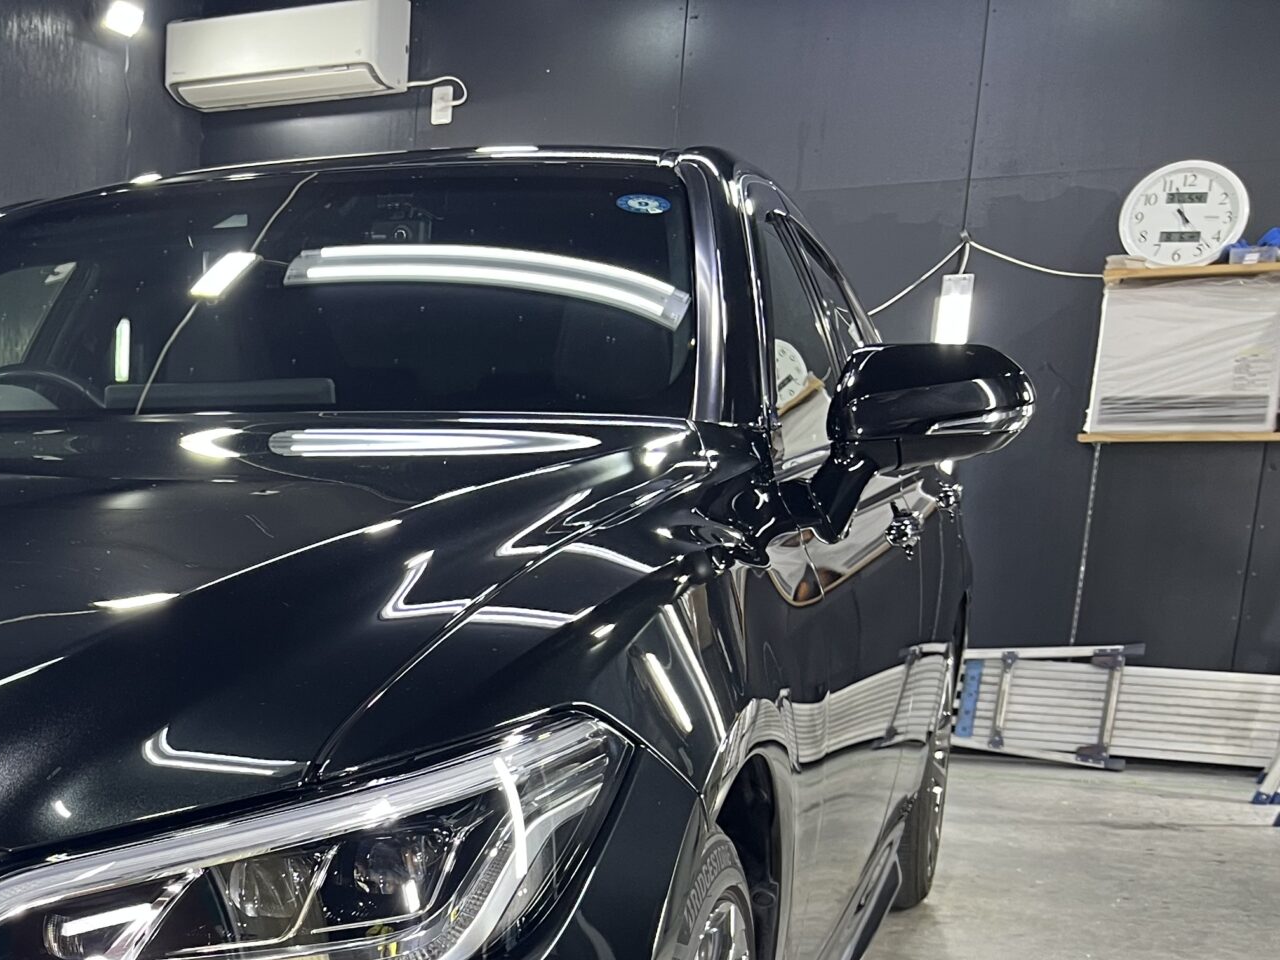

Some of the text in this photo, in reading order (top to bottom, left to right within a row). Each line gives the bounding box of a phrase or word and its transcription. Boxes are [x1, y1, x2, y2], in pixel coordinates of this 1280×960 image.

[1162, 177, 1173, 192] 11
[1183, 173, 1198, 187] 12
[1208, 178, 1214, 192] 1
[1141, 193, 1158, 206] 10
[1218, 192, 1229, 205] 2
[1135, 212, 1144, 224] 9
[1222, 211, 1233, 224] 3
[1138, 230, 1147, 243] 8
[1211, 229, 1221, 242] 4
[1153, 244, 1161, 256] 7
[1172, 249, 1181, 262] 6
[1193, 243, 1204, 257] 5
